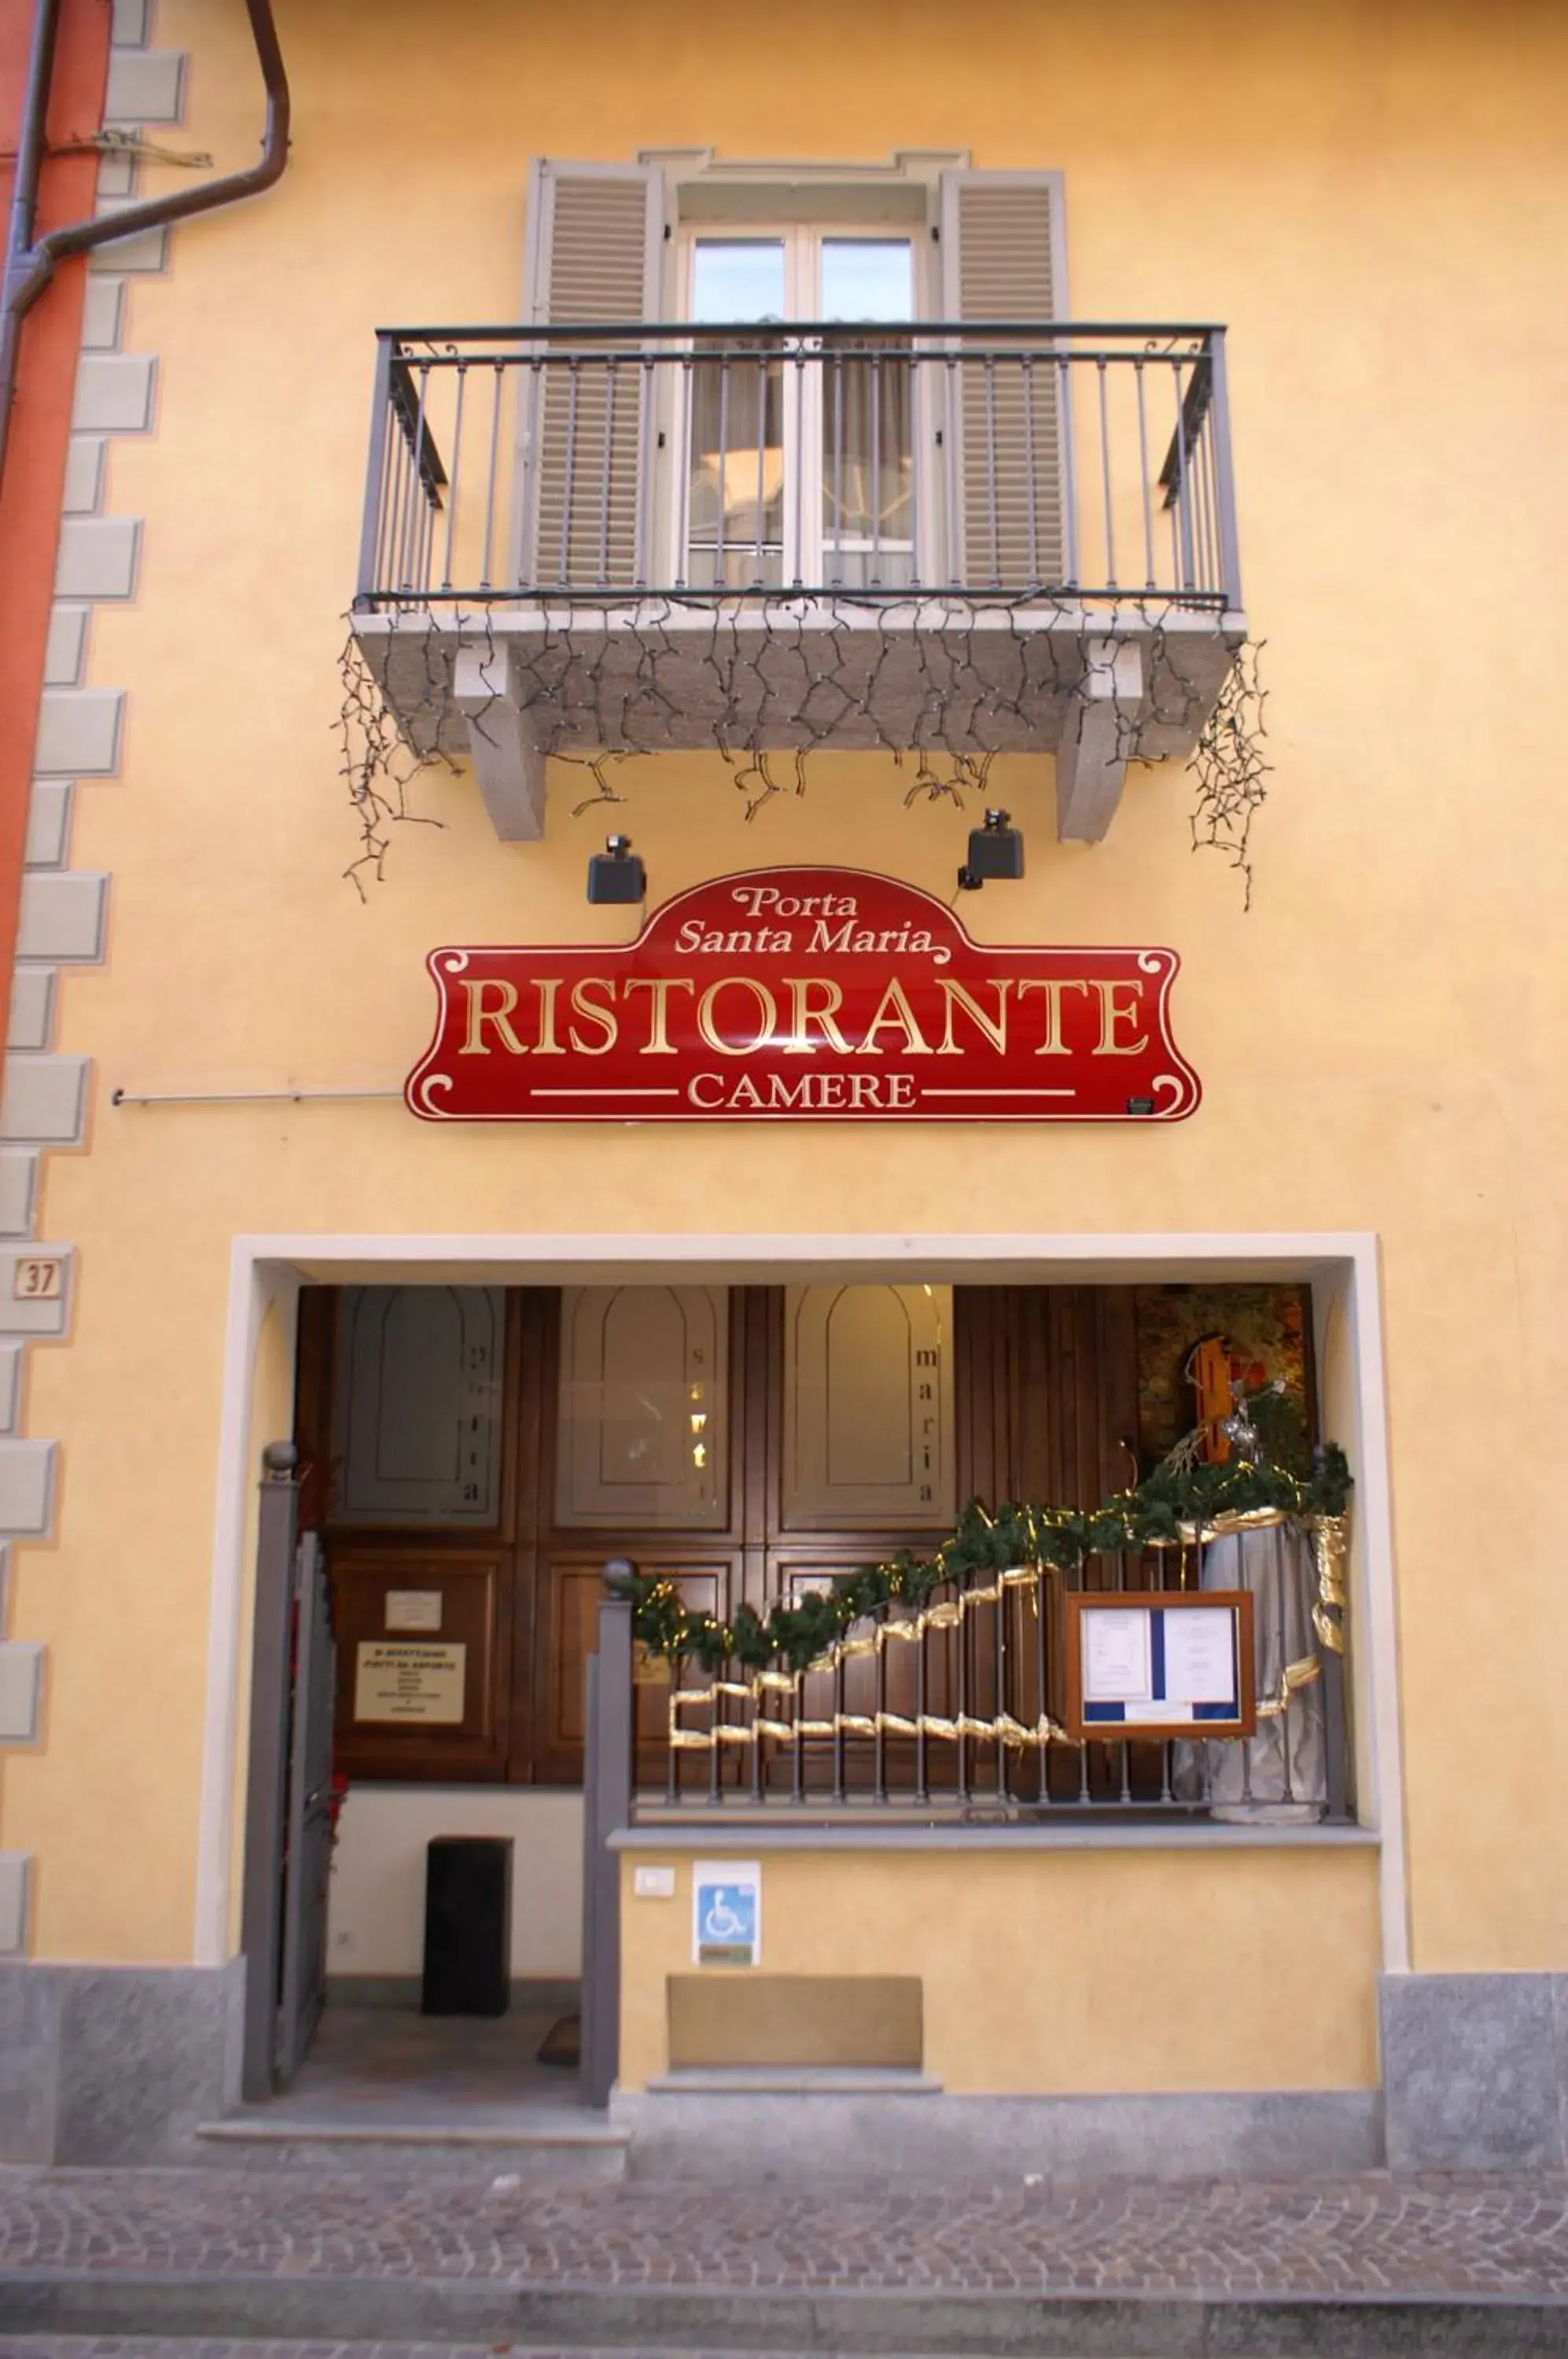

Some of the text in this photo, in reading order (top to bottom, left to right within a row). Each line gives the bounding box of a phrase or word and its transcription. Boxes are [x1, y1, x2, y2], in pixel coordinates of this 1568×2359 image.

[731, 886, 858, 917] Porta
[675, 919, 951, 964] Santa Maria
[457, 976, 1150, 1057] RISTORANTE
[687, 1073, 917, 1108] CAMERE
[26, 1263, 54, 1294] 37
[915, 1349, 938, 1502] maria
